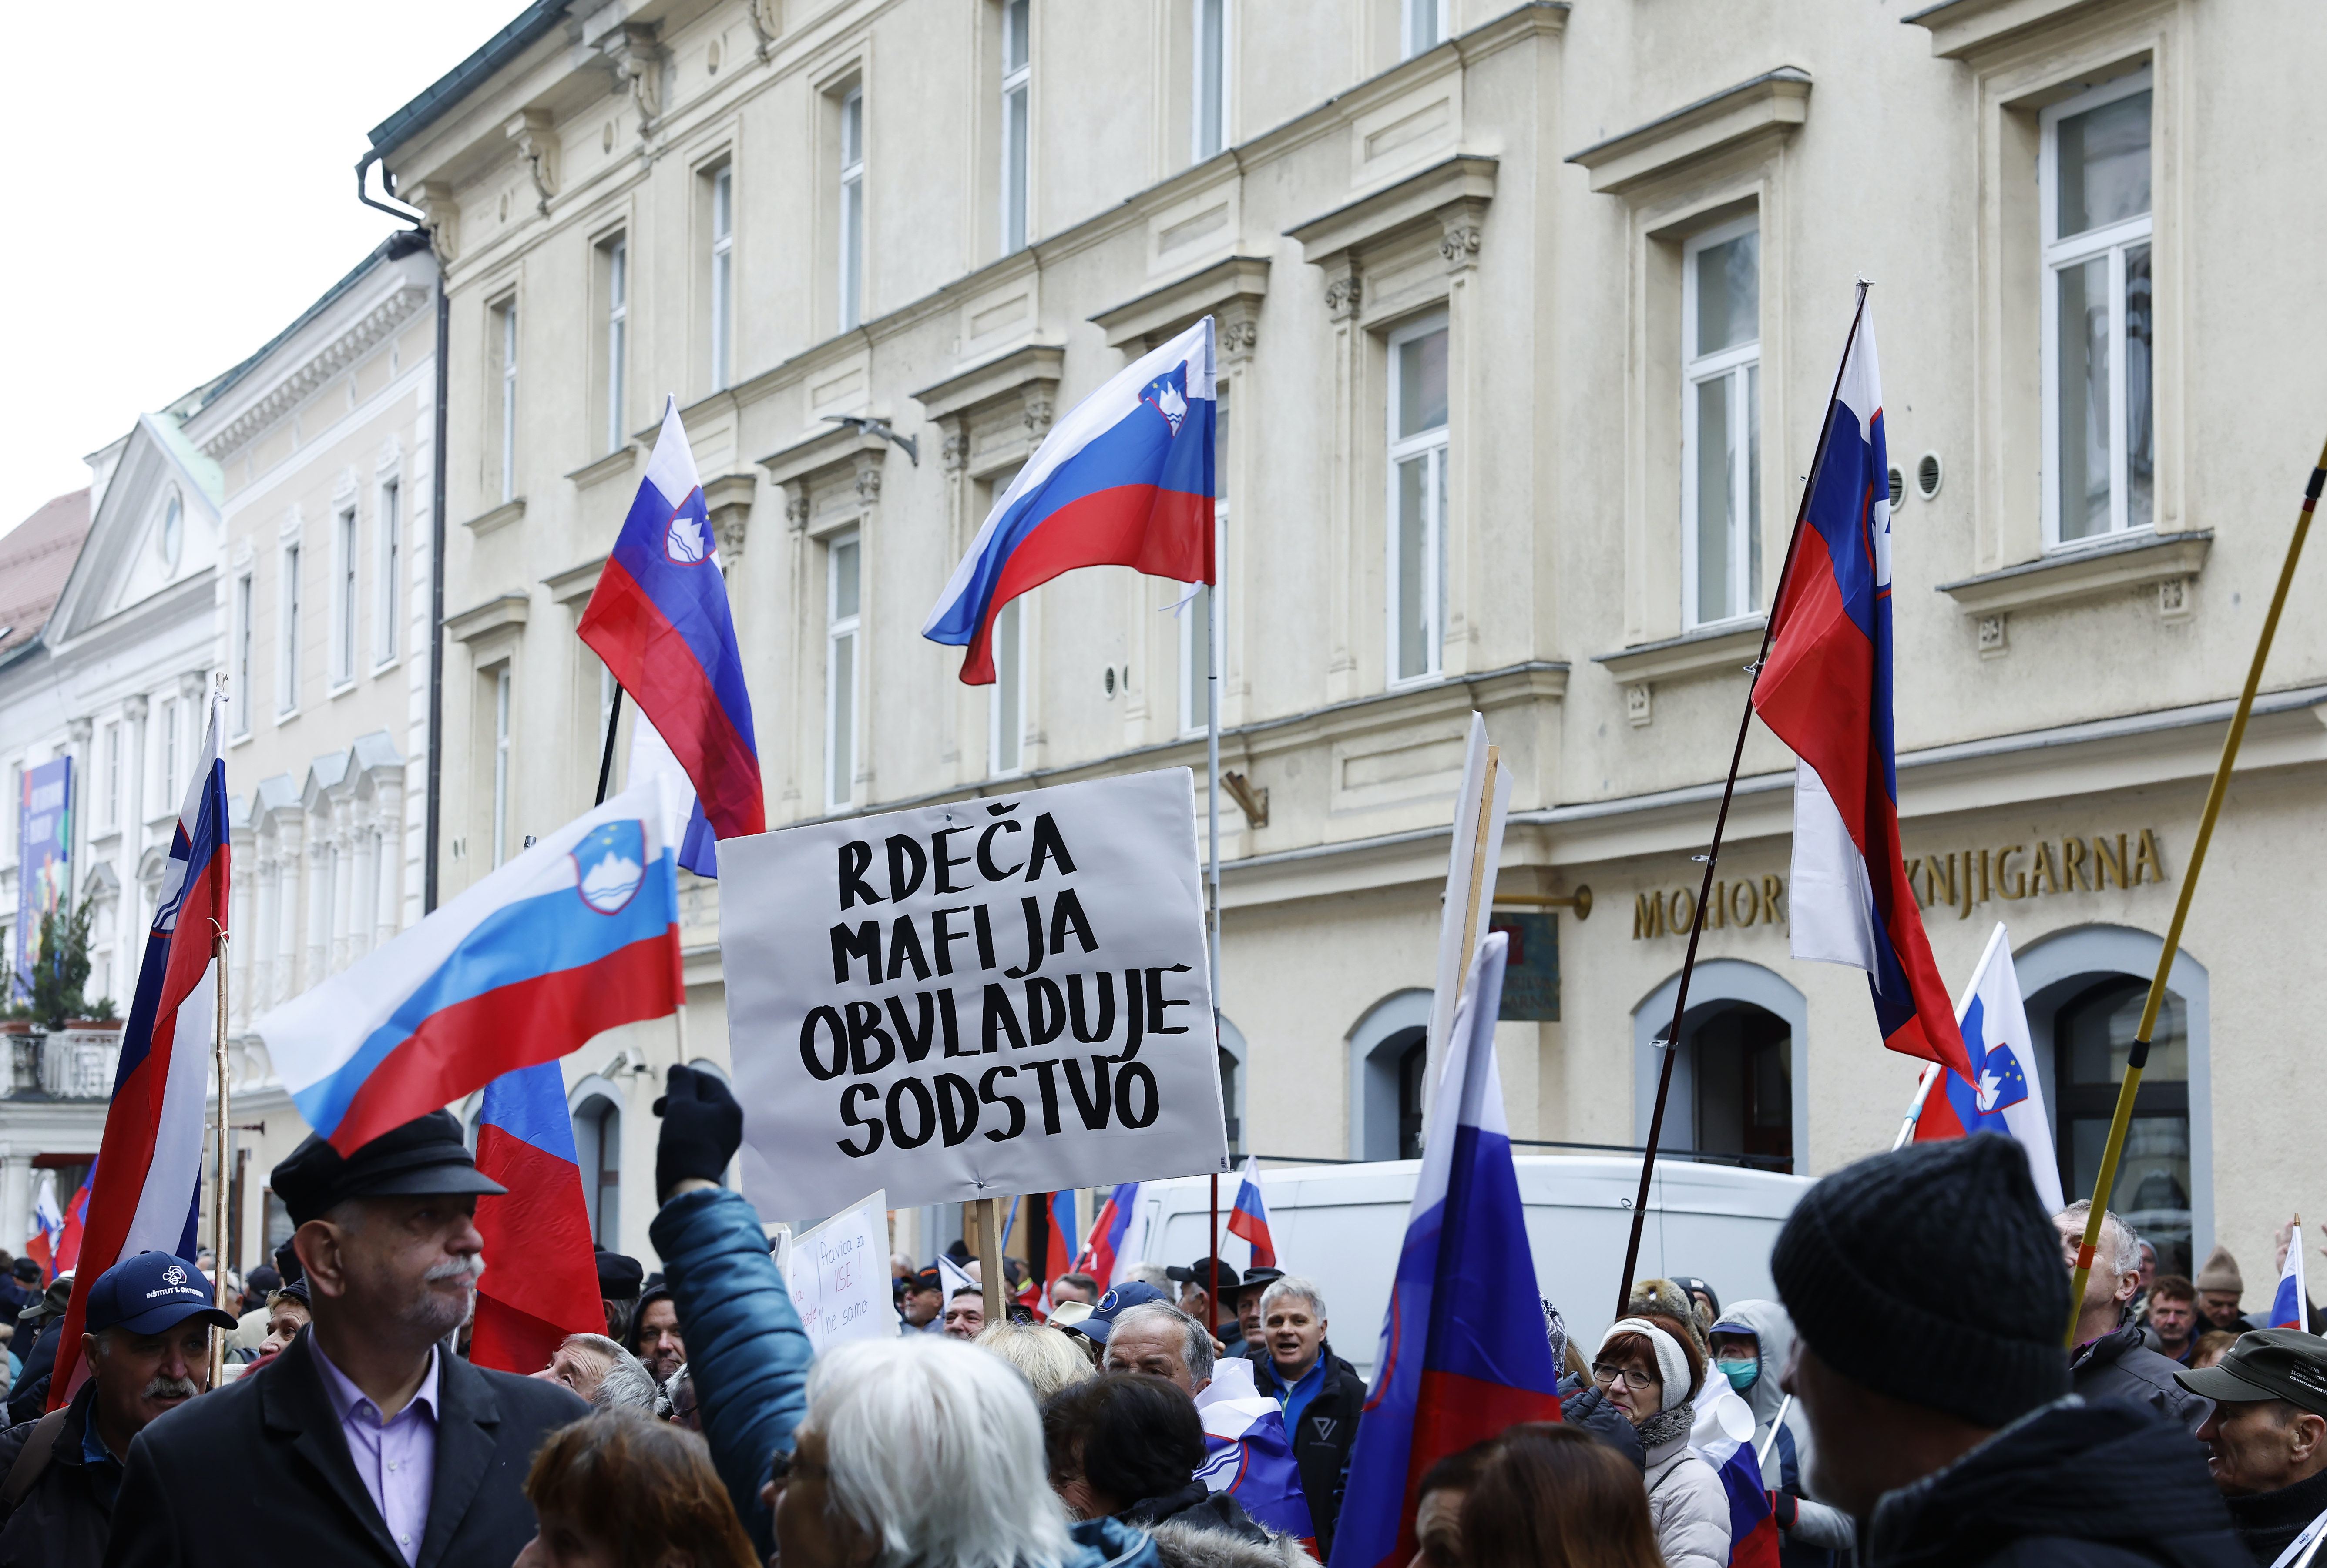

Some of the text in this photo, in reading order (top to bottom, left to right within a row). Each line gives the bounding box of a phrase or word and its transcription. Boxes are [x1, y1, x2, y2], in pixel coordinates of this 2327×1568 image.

[838, 802, 1077, 911] RDEČA
[829, 888, 1099, 986] MAFIJA
[1633, 874, 1790, 940] MOHOR
[799, 963, 1192, 1081] OBVLADUJE
[836, 1056, 1159, 1158] SODSTVO
[820, 1236, 865, 1265] Pravica za
[834, 1261, 852, 1293] VSE
[146, 1287, 174, 1299] INŠTITUT
[826, 1300, 868, 1334] ne samo
